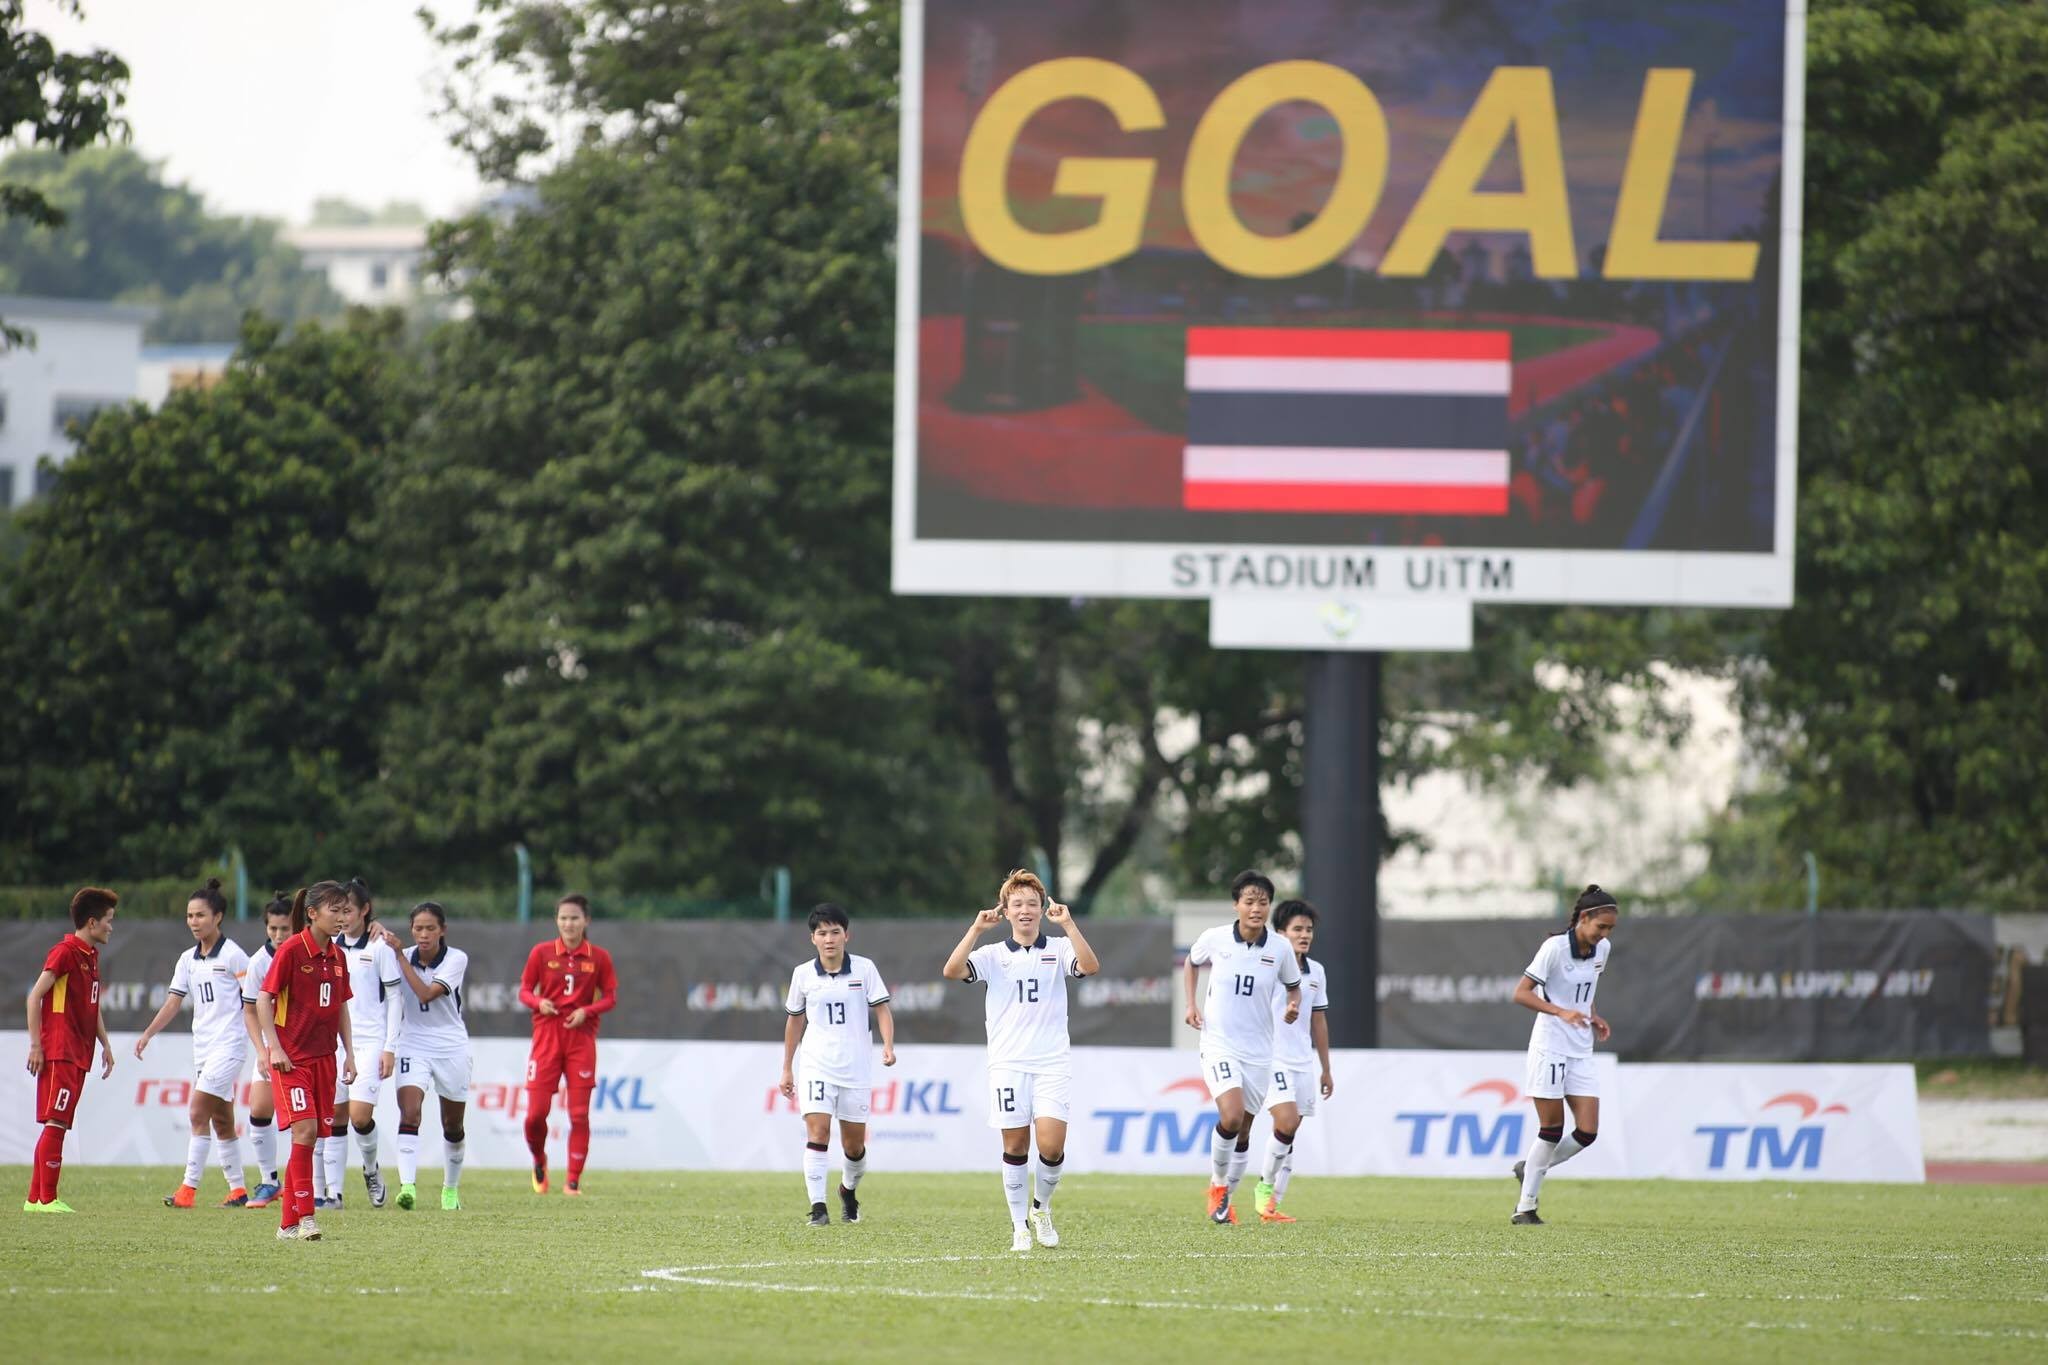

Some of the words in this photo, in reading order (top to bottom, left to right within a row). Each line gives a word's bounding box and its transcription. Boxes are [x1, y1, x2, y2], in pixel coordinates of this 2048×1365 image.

[958, 56, 1762, 281] GOAL
[1172, 553, 1376, 589] STADIUM
[1405, 556, 1514, 591] UiTM
[198, 981, 215, 1004] 10
[319, 982, 332, 1008] 19
[563, 974, 574, 996] 3
[1016, 978, 1039, 1004] 12
[1234, 973, 1255, 997] 19
[1574, 981, 1592, 1003] 17
[825, 1001, 846, 1025] 13
[527, 1059, 537, 1082] 3
[1211, 1060, 1232, 1084] 19
[1274, 1071, 1288, 1092] 9
[1550, 1062, 1567, 1085] 17
[54, 1087, 71, 1112] 13
[290, 1087, 308, 1112] 19
[807, 1080, 825, 1101] 13
[996, 1087, 1016, 1113] 12
[1090, 1109, 1219, 1156] TM
[1394, 1112, 1526, 1157] TM
[1693, 1125, 1826, 1170] TM
